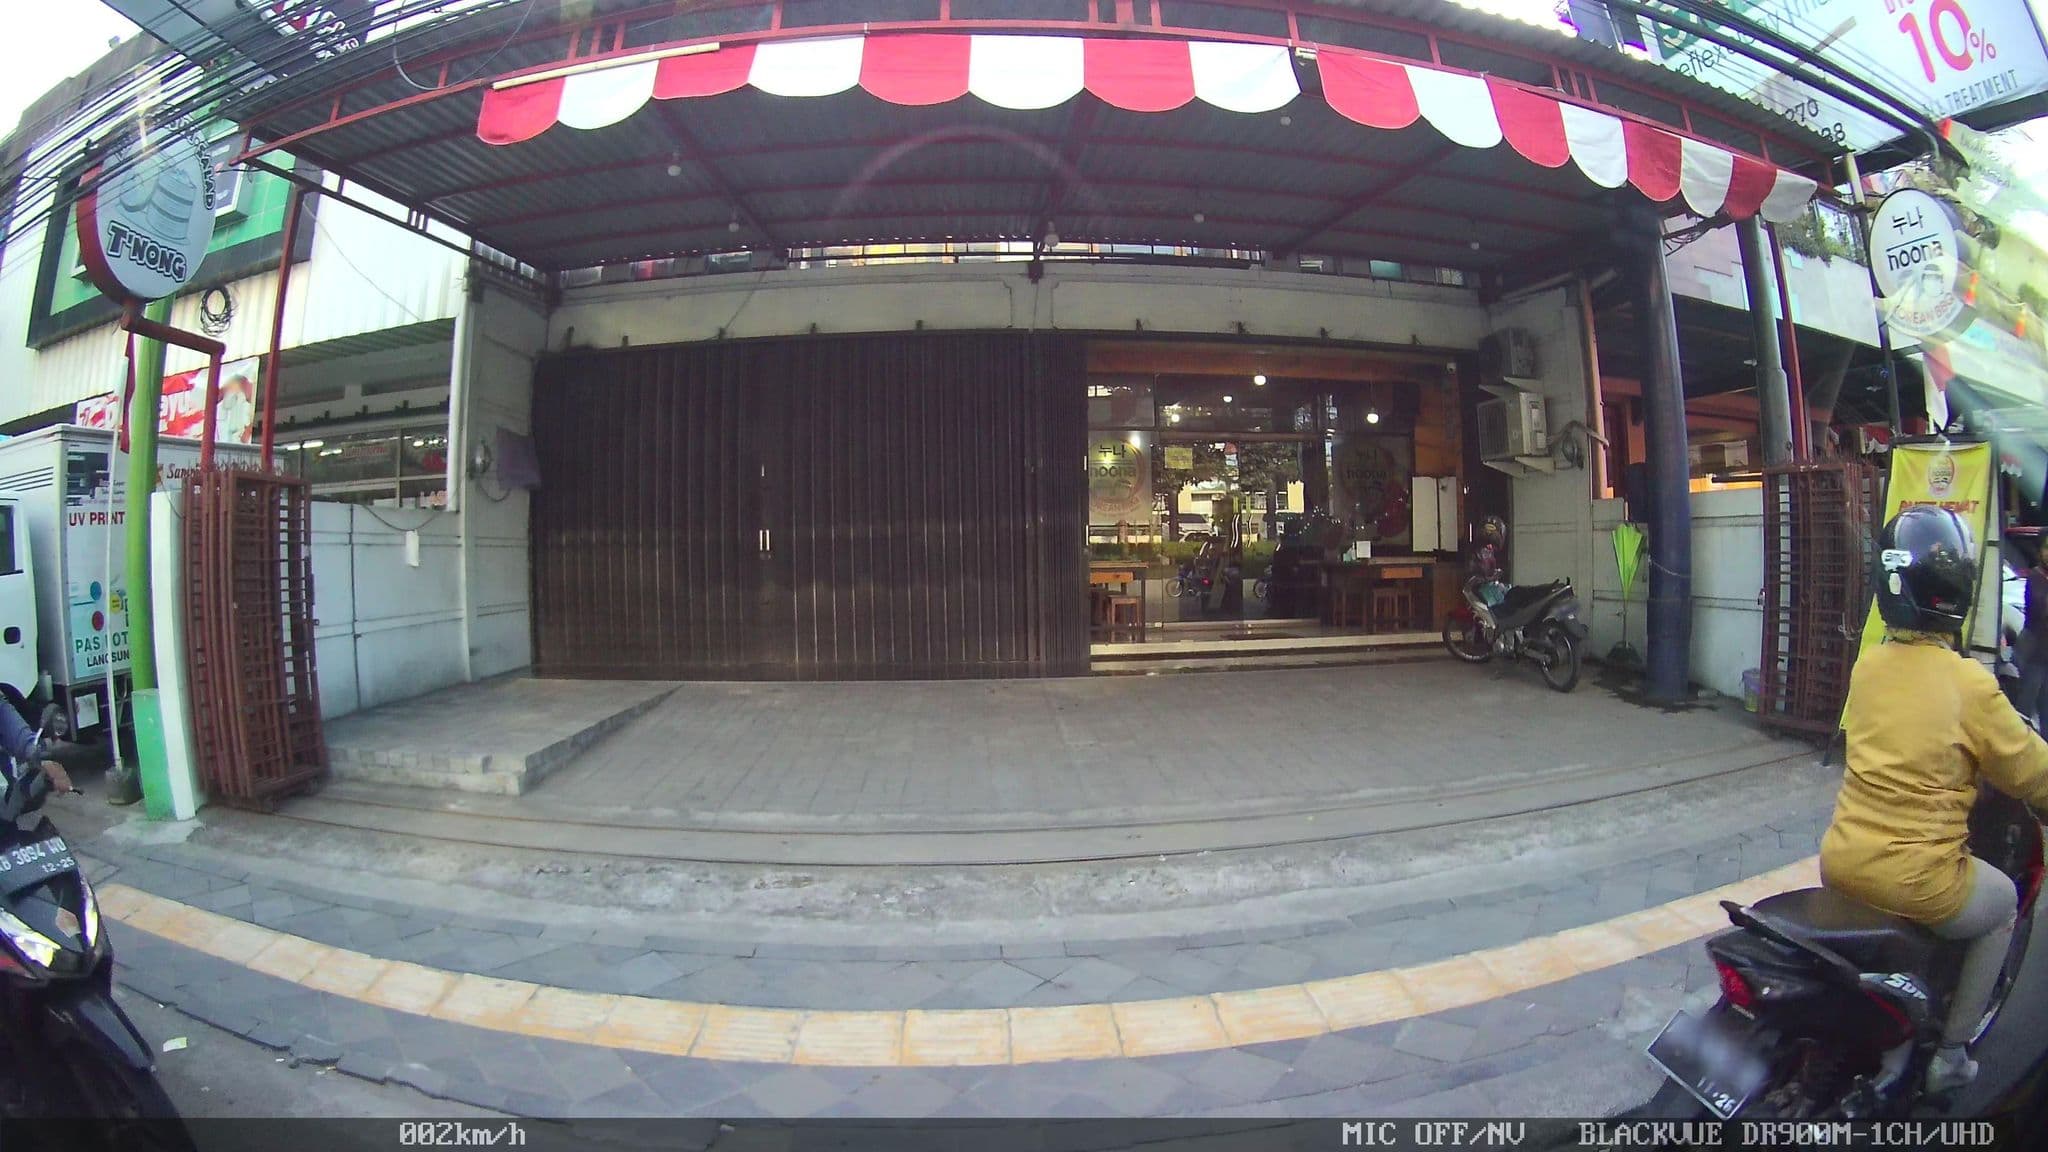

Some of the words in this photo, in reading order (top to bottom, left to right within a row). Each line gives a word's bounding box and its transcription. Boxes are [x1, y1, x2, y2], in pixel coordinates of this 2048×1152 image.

[1898, 0, 1997, 83] 10%
[1945, 69, 2018, 112] TREATMENT
[1892, 206, 1923, 235] 누나
[1887, 240, 1944, 271] noona
[1098, 444, 1127, 458] 누나
[69, 512, 85, 526] UV
[76, 636, 101, 653] PAS
